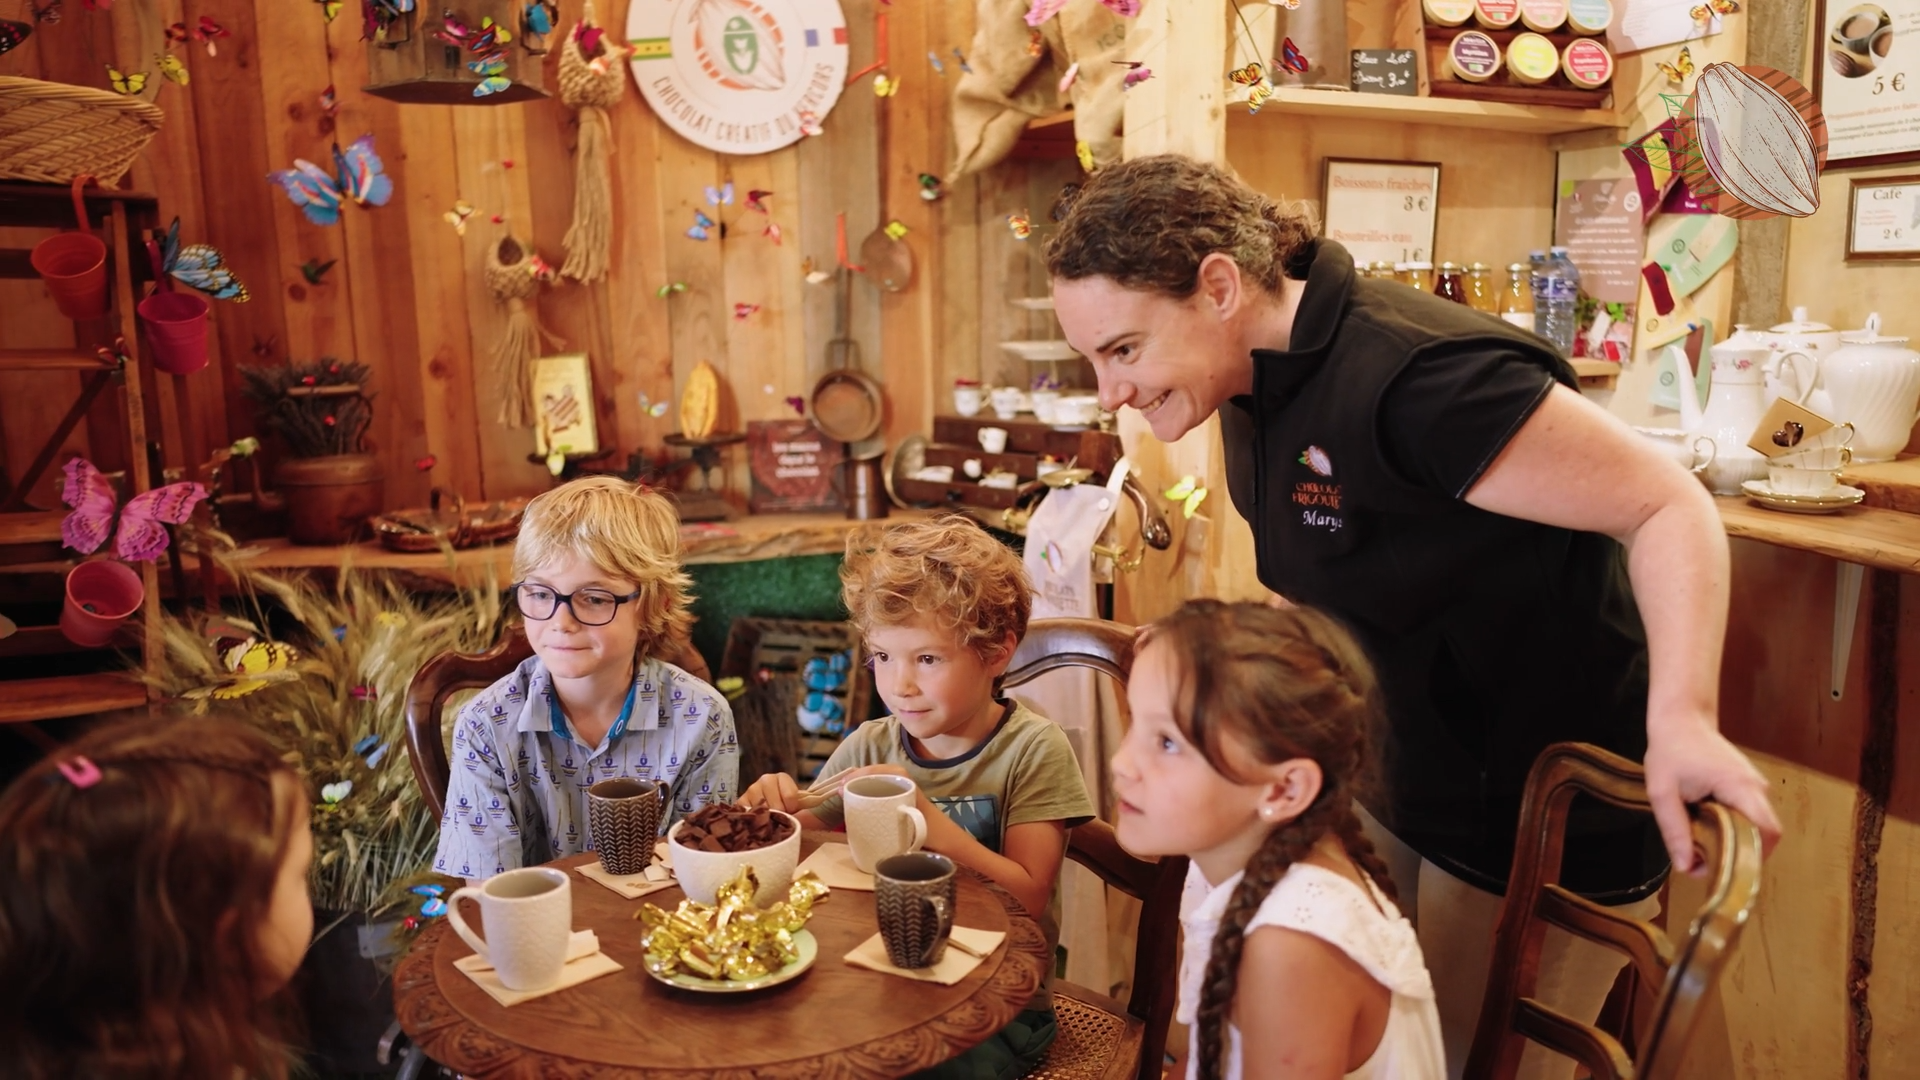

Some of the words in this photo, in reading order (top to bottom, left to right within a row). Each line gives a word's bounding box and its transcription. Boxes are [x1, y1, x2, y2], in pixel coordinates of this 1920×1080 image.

[1872, 76, 1884, 95] 5
[1891, 72, 1905, 92] €
[653, 76, 712, 134] CHOCOLAT
[774, 113, 795, 135] DU
[1333, 175, 1383, 189] Boissons
[1872, 188, 1902, 200] Café
[1403, 195, 1414, 211] 3
[1418, 195, 1429, 212] €
[1883, 228, 1891, 239] 2
[1894, 227, 1903, 239] €
[1402, 248, 1408, 263] 1
[1412, 248, 1423, 262] €
